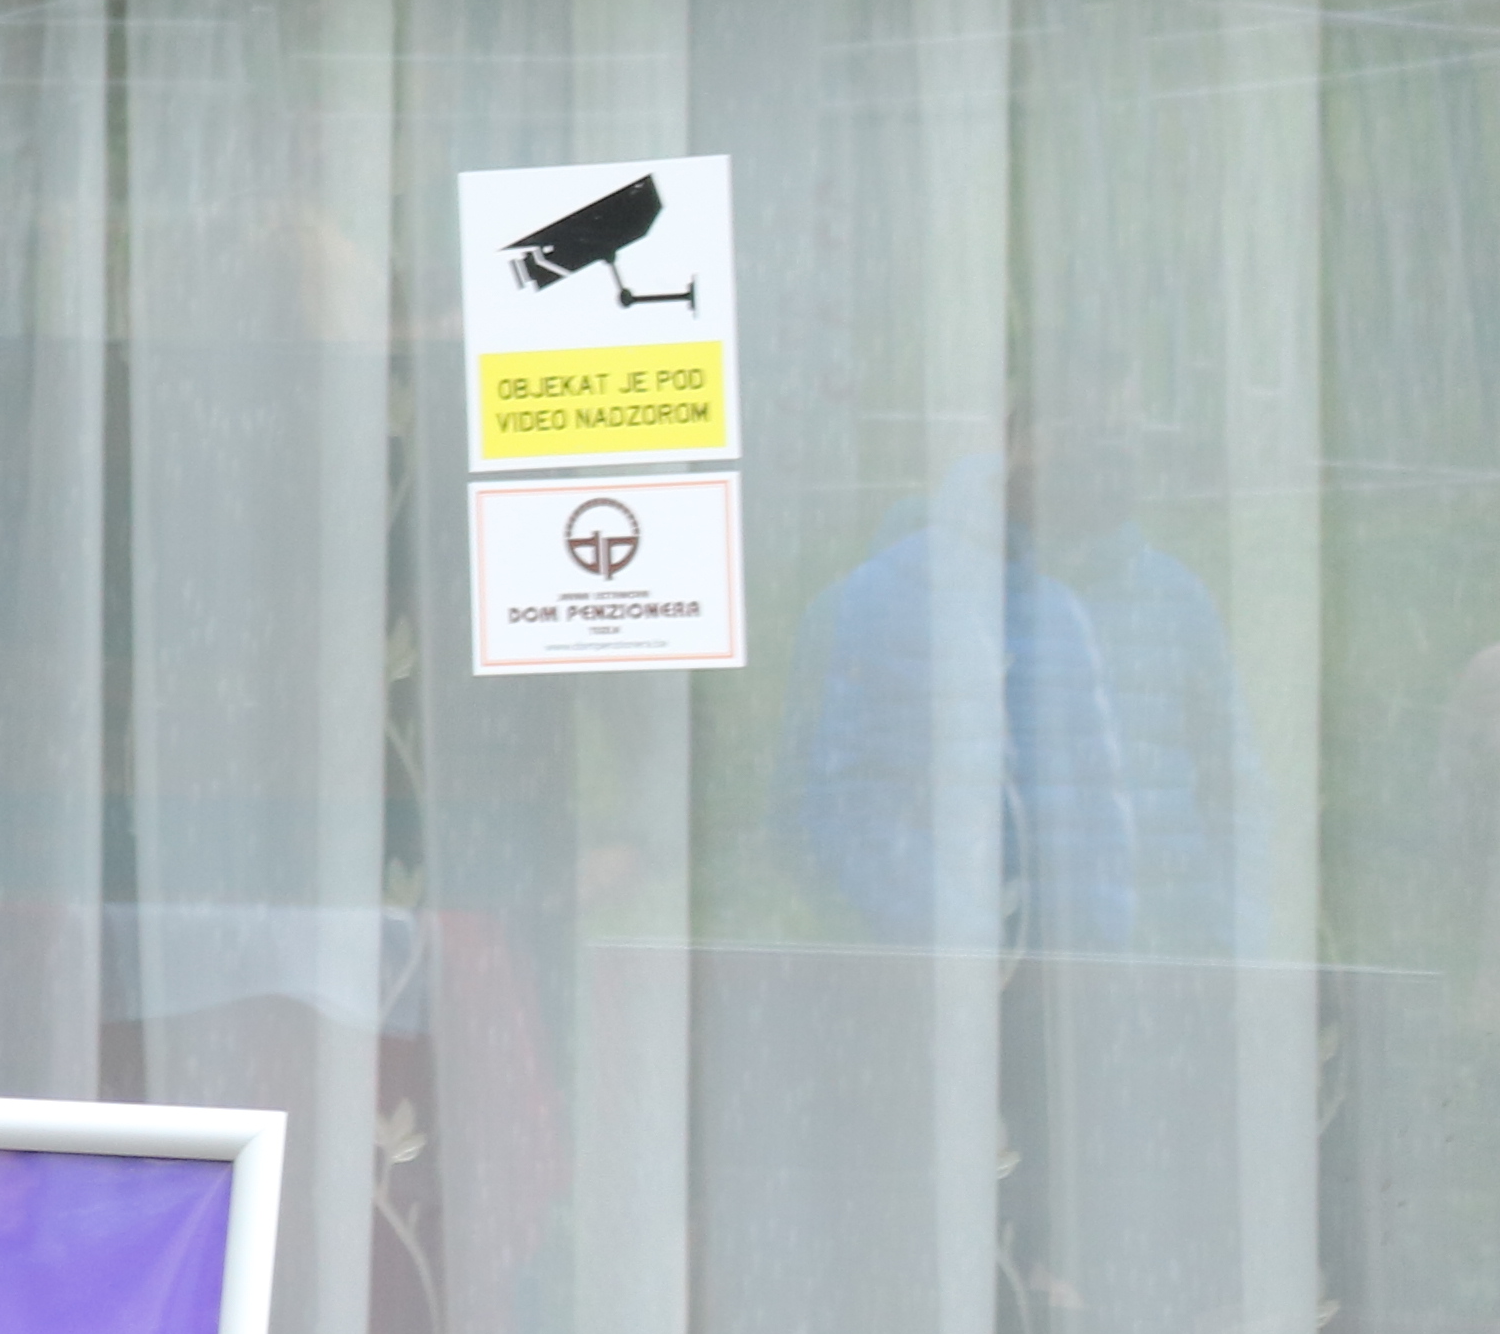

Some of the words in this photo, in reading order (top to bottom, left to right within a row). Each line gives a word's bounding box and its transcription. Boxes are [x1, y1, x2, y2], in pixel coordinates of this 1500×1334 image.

[498, 373, 609, 400] OBJEKAT
[618, 371, 649, 394] JE
[656, 368, 705, 392] POD
[497, 409, 566, 434] VIDEO
[575, 402, 710, 429] NADZOROM
[508, 606, 557, 624] DOM
[566, 600, 701, 622] PENZIONERA
